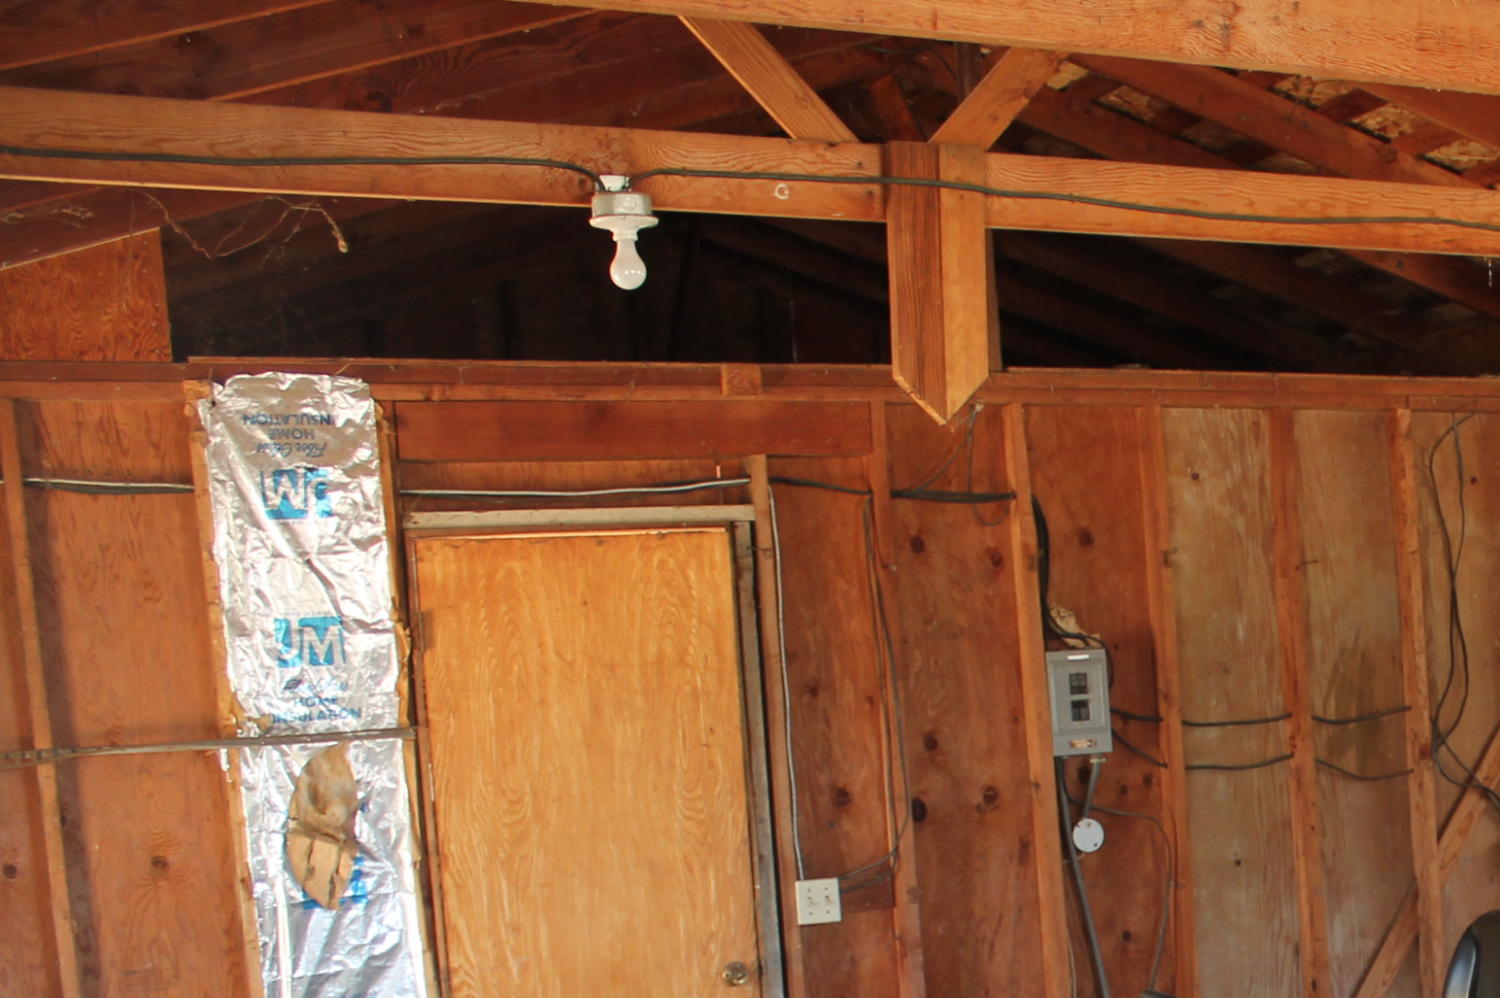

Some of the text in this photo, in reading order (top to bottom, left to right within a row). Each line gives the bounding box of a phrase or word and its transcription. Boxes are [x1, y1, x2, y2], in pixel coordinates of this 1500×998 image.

[243, 413, 333, 428] INSULATION
[268, 428, 315, 440] HOME
[274, 617, 346, 668] JM
